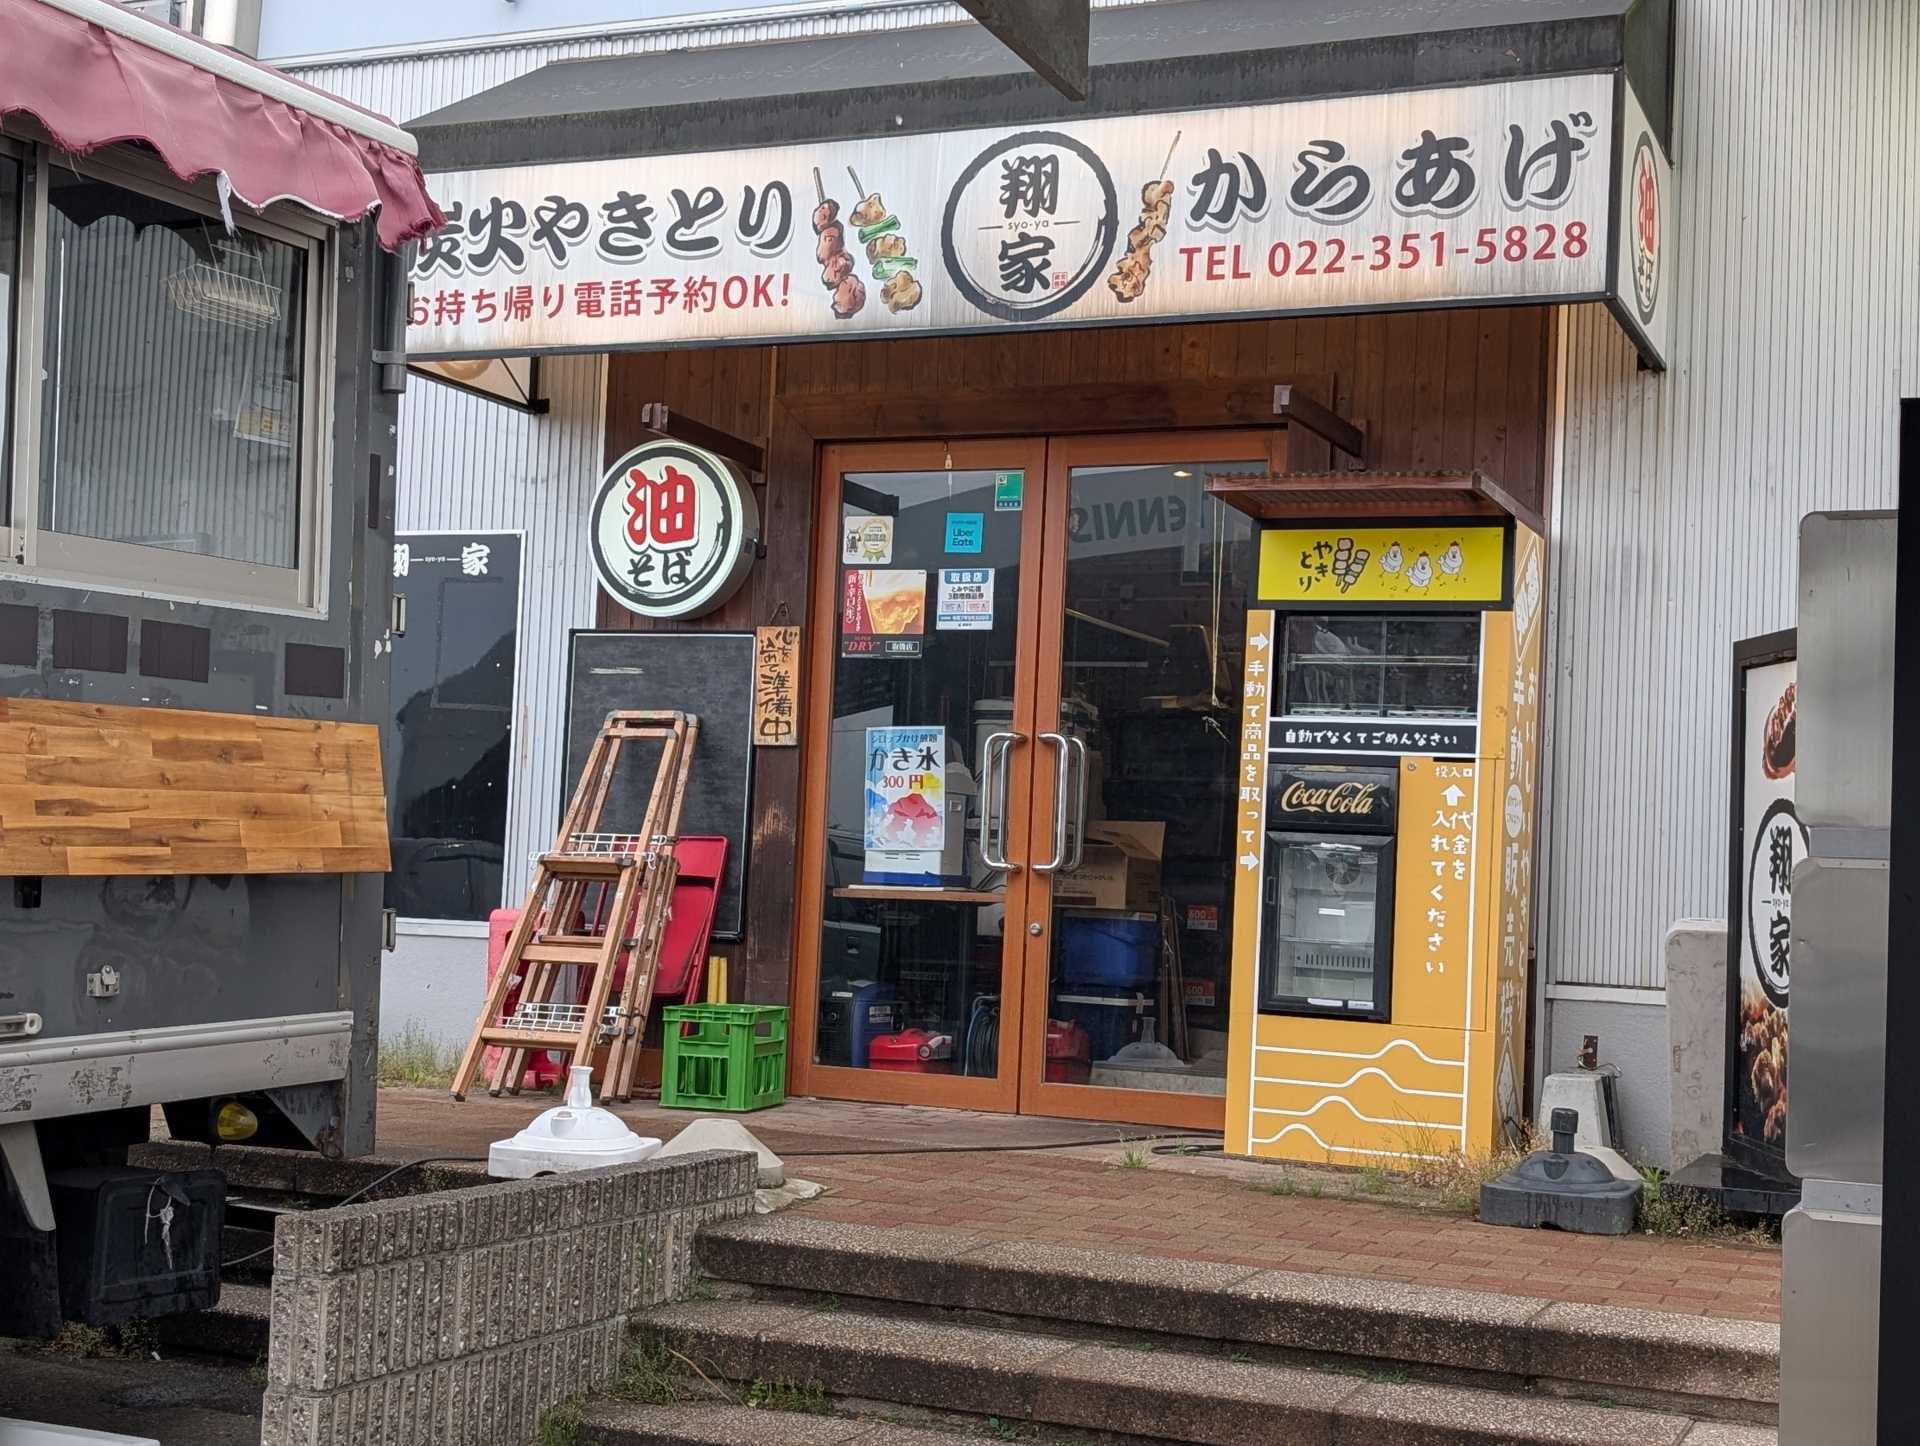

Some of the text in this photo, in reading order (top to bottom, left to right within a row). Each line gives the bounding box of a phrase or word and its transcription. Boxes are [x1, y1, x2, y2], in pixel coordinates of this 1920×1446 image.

[999, 153, 1060, 219] 翔
[1191, 111, 1593, 225] からあげ
[1006, 219, 1050, 233] syo-ya
[1179, 221, 1588, 282] TEL 022-351-5828
[998, 231, 1056, 294] 家
[625, 464, 697, 546] 油
[461, 541, 491, 576] 家
[626, 549, 693, 588] そば
[758, 670, 793, 743] 準備中
[868, 745, 942, 772] かき氷
[1239, 659, 1265, 844] 手動で商品を取って
[1284, 729, 1458, 746] 自動でなくてごめんなさい
[882, 774, 925, 790] 300 円
[1280, 780, 1380, 815] Coca-Cola
[1434, 765, 1474, 779] 投入口
[1448, 809, 1475, 881] 代金を
[1425, 809, 1451, 974] 入れてください
